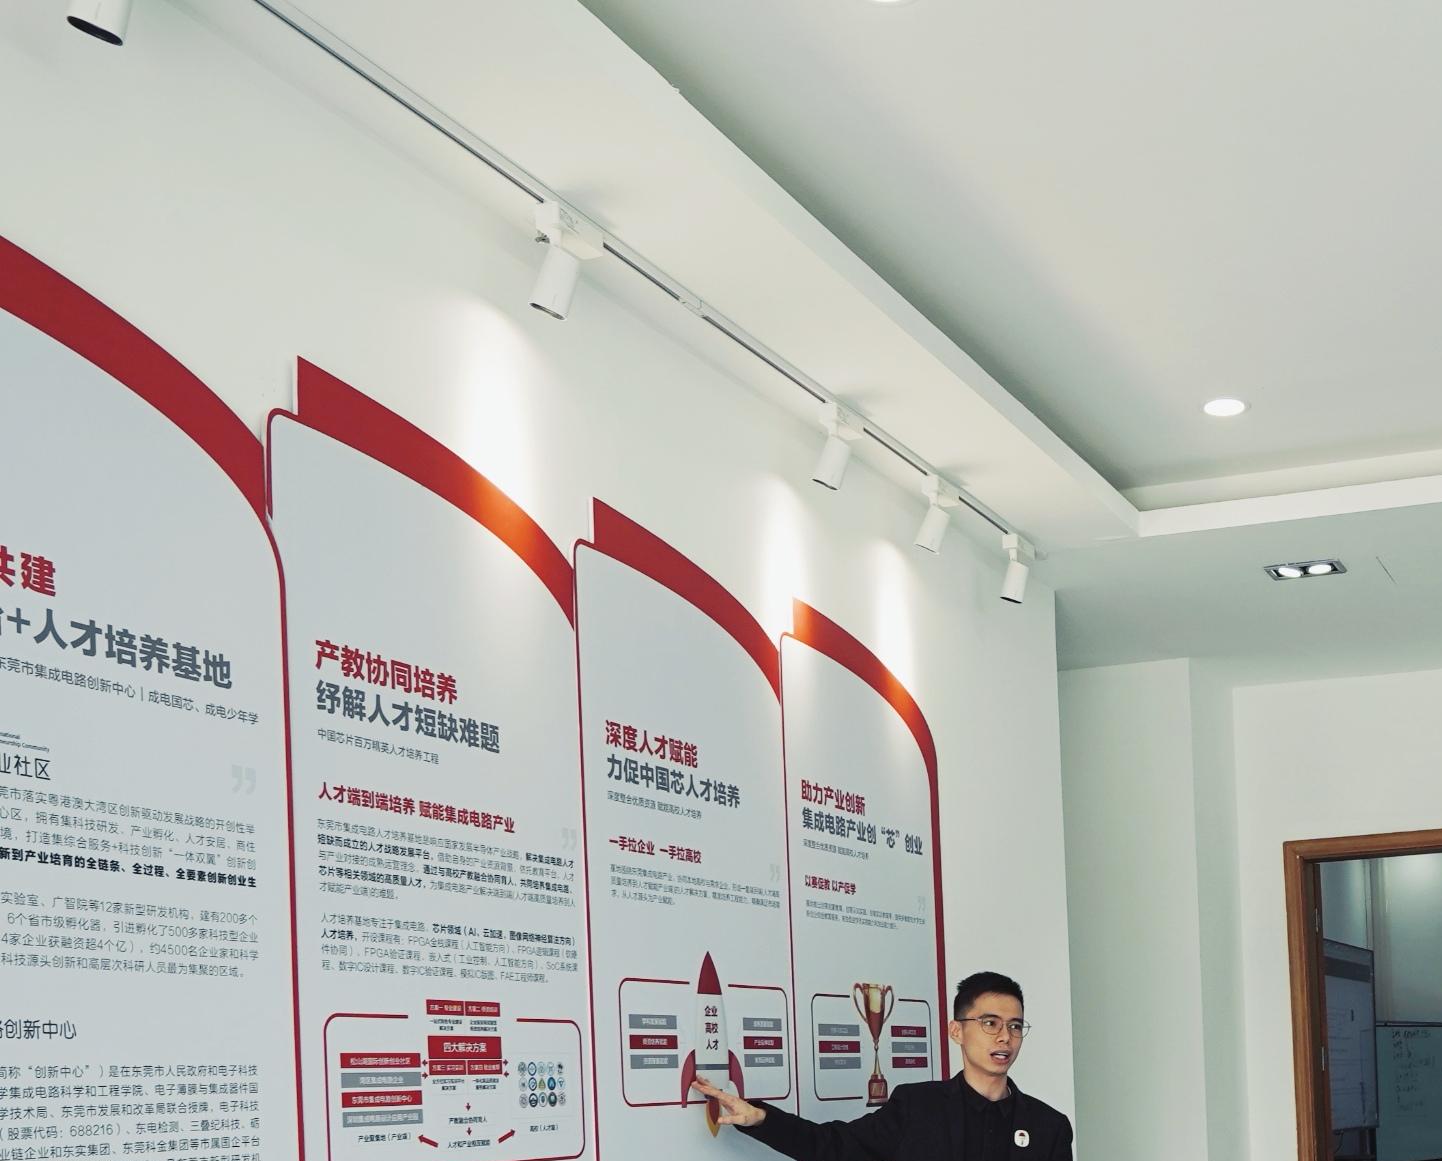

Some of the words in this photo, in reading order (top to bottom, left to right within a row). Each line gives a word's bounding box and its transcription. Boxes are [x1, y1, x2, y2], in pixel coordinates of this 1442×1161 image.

[0, 607, 233, 690] +人才培养基地
[315, 639, 458, 704] 产教协同培养
[316, 680, 500, 754] 纾解人才短缺难题
[605, 719, 698, 768] 深度人才赋能
[607, 754, 741, 808] 力促中国芯人才培养
[801, 779, 866, 817] 助力产业创新
[319, 781, 415, 815] 人才端到端培养
[419, 800, 515, 833] 赋能集成电路产业
[609, 835, 656, 856] 一手拉企业
[659, 845, 702, 864] 一手拉高校
[0, 1019, 77, 1040] 创新中心
[704, 1005, 718, 1017] 企业
[704, 1022, 719, 1034] 高校
[705, 1039, 719, 1051] 人才
